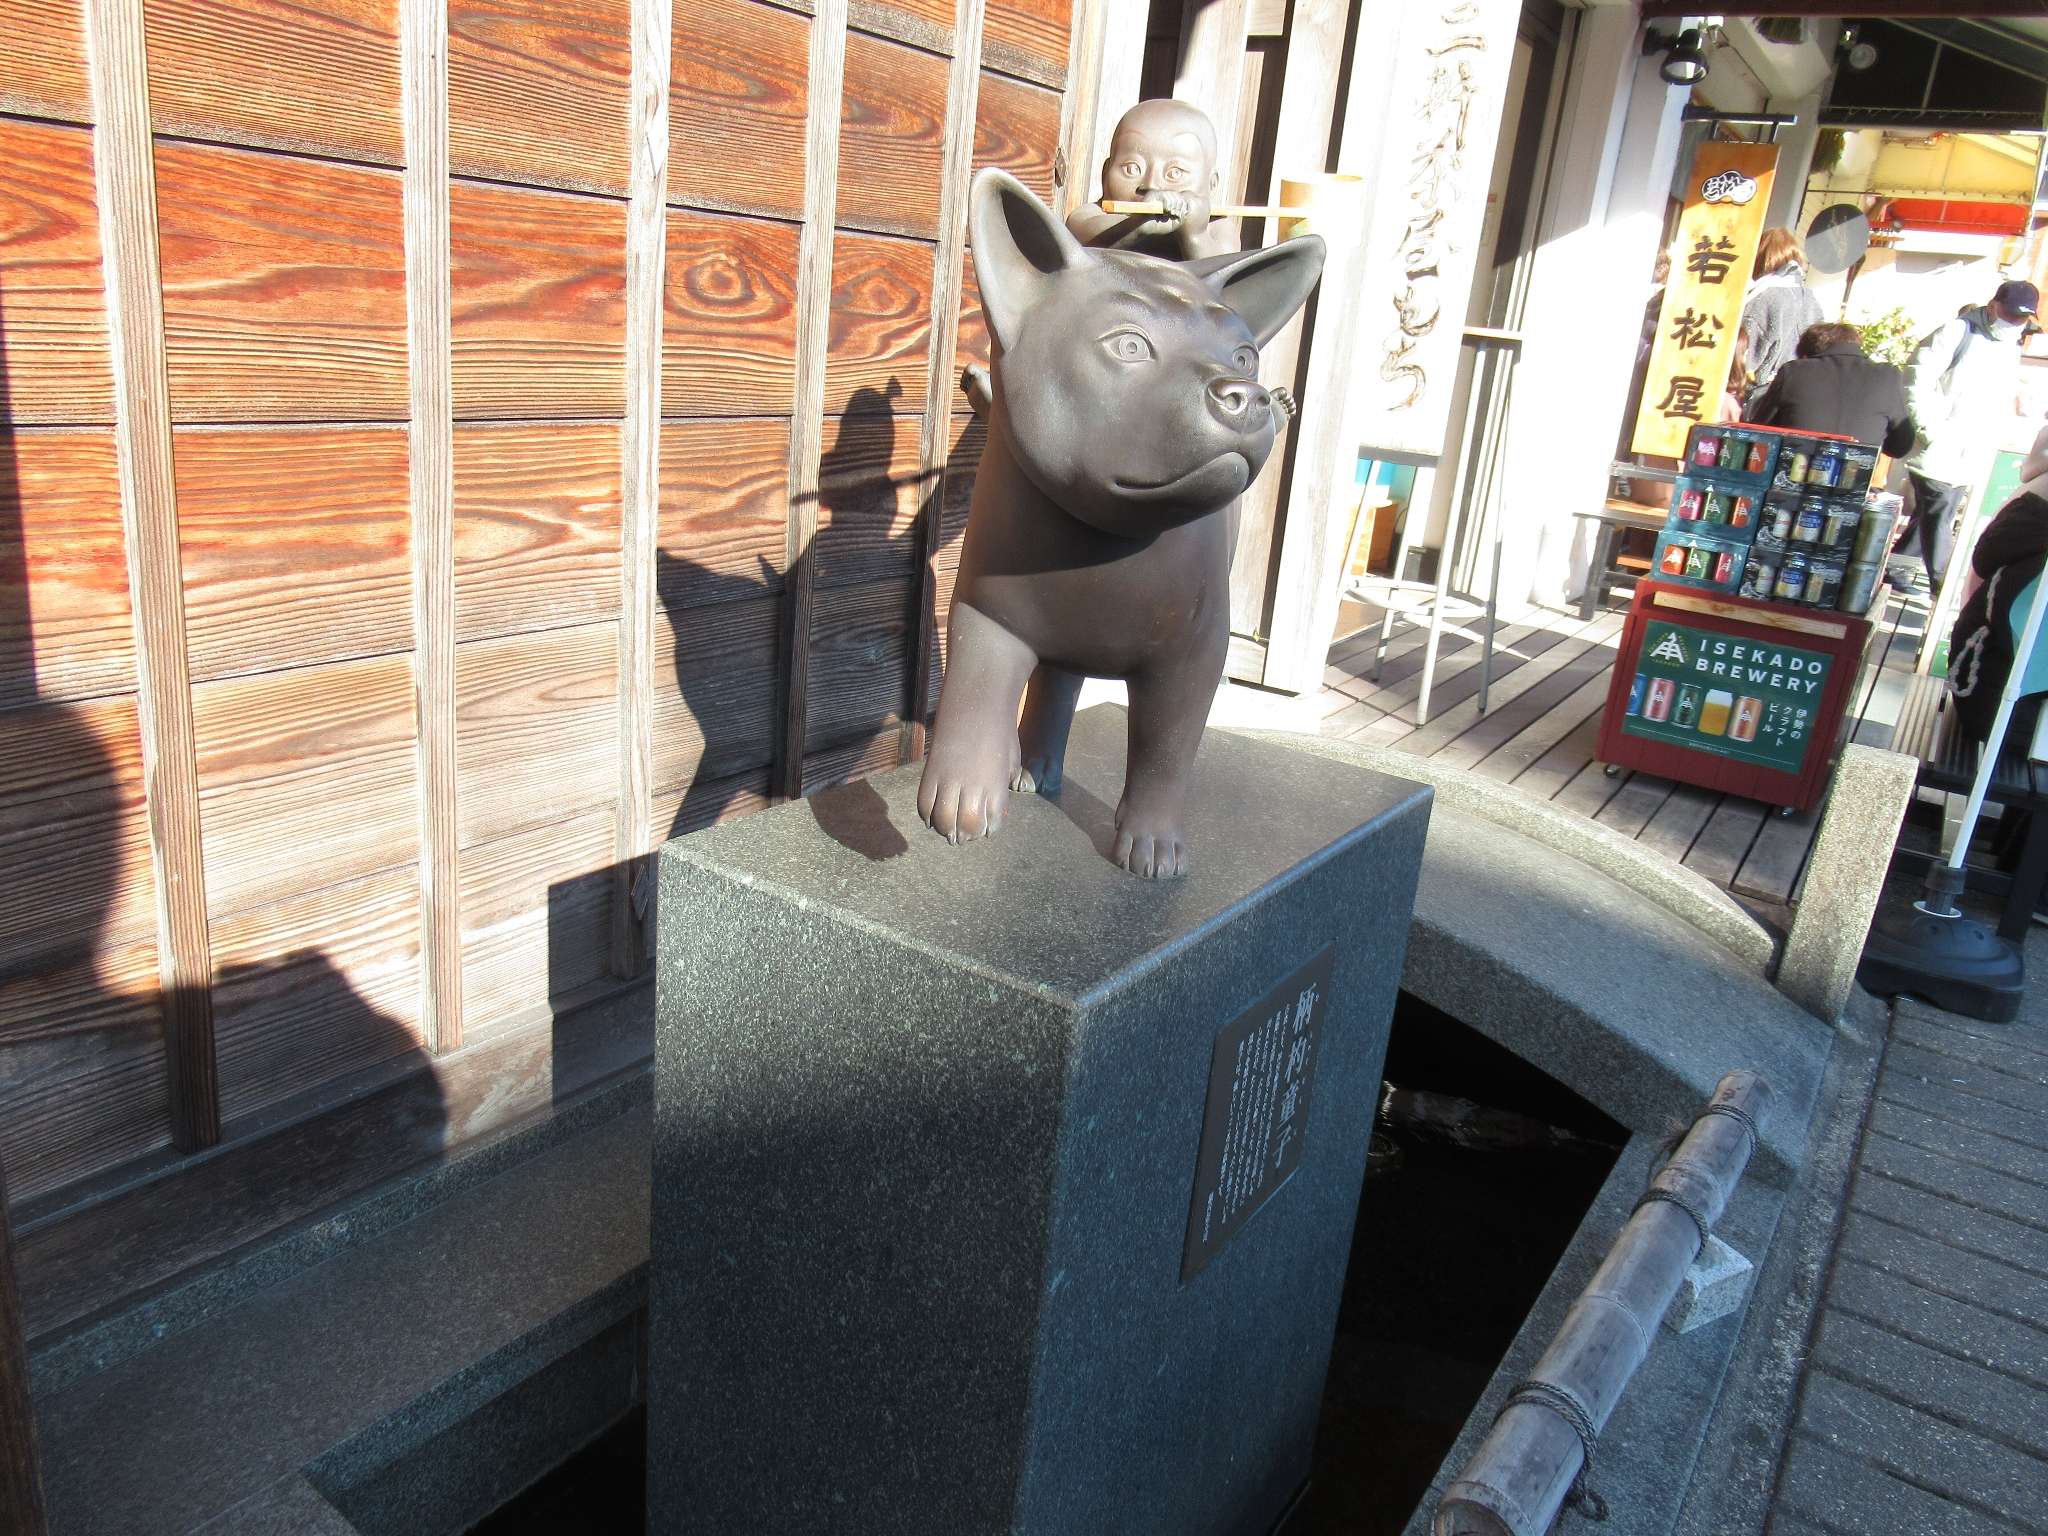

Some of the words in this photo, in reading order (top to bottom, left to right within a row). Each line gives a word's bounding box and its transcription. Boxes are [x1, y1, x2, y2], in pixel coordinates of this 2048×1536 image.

[1656, 235, 1740, 422] 若松屋
[1699, 639, 1823, 675] ISEKADO
[1695, 658, 1819, 694] BREWERY
[1762, 703, 1780, 732] ビール
[1775, 706, 1793, 747] クラフト
